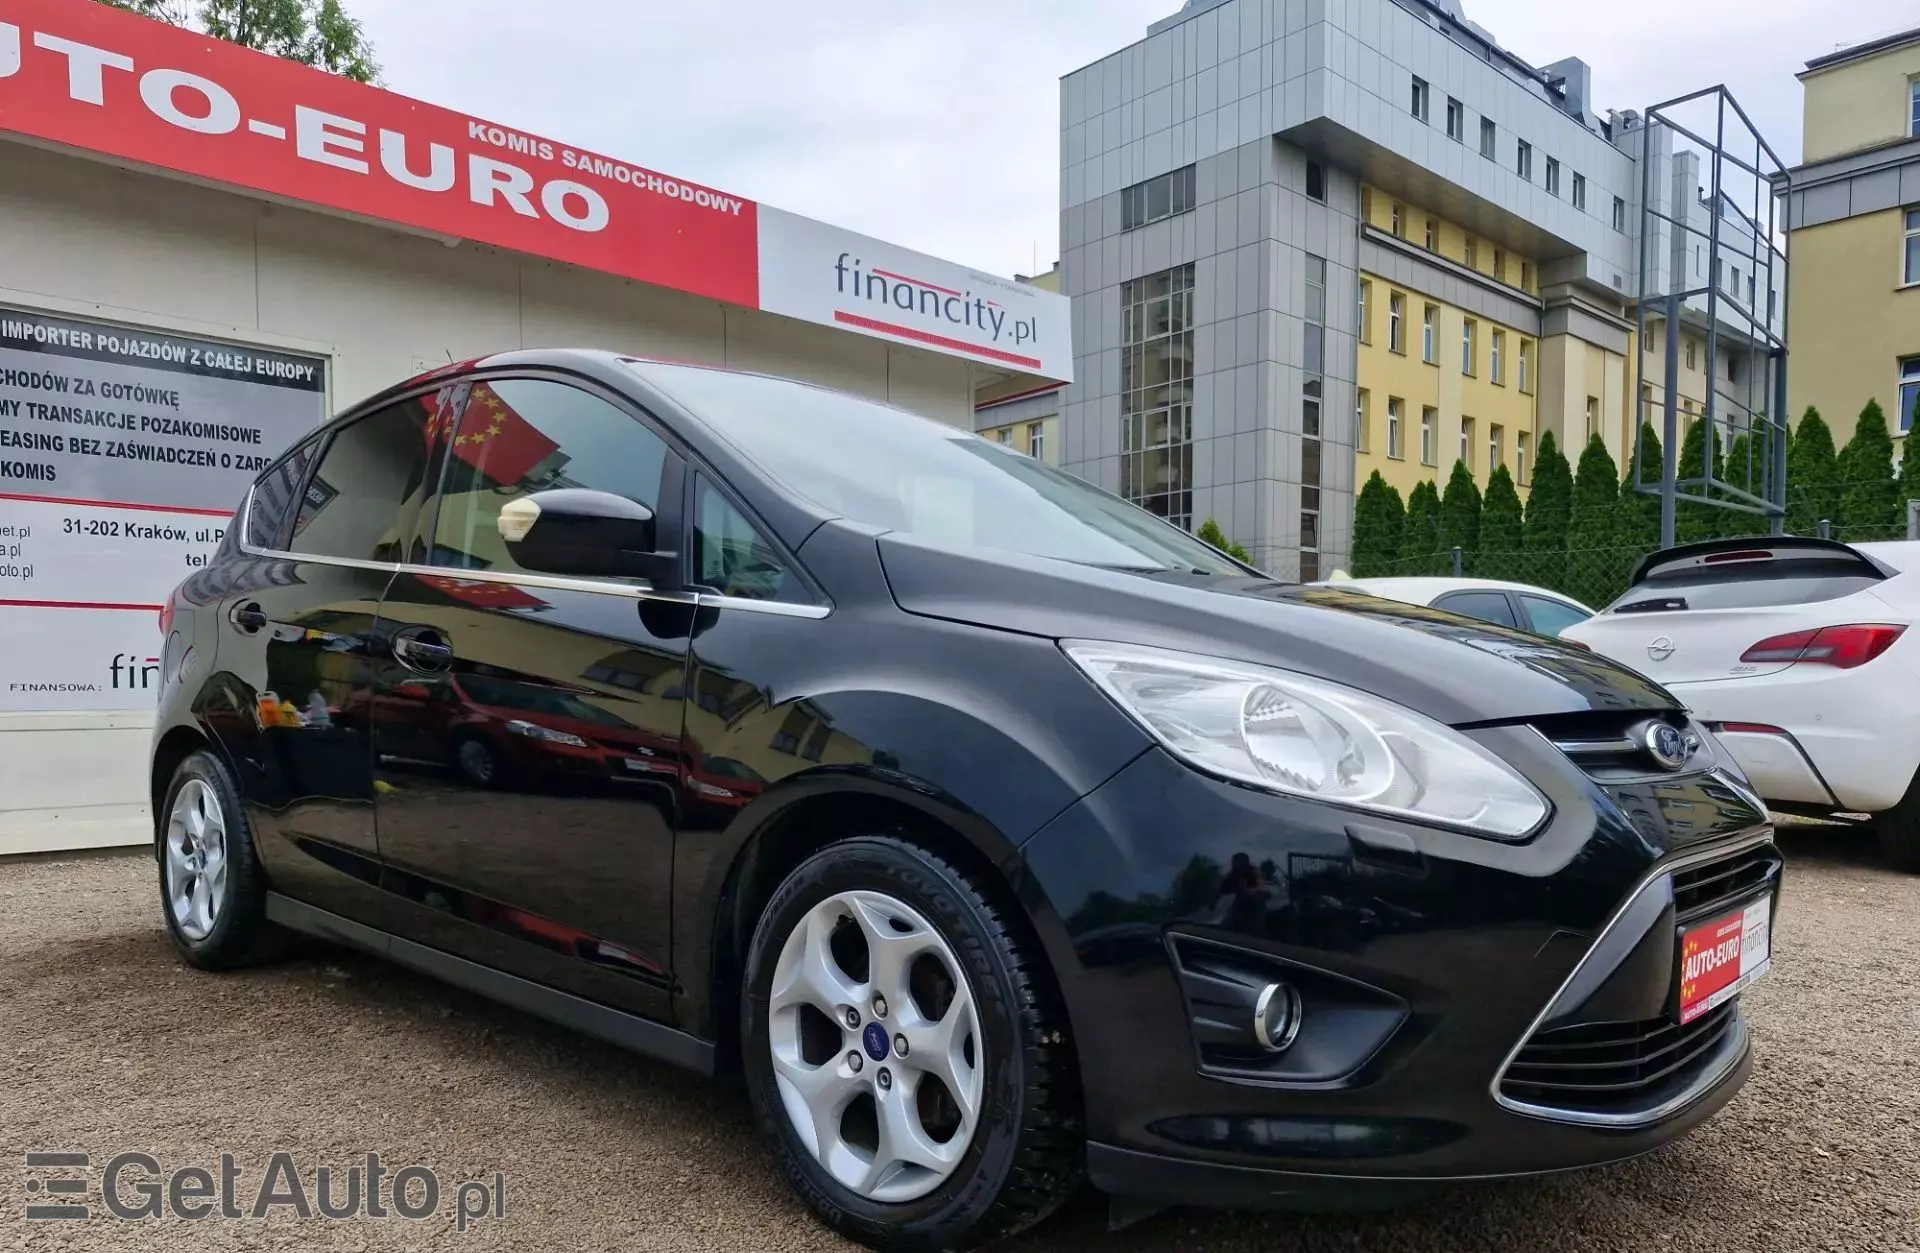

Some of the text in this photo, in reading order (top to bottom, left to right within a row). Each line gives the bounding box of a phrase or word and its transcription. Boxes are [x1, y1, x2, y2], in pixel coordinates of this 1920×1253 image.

[0, 22, 610, 233] TO-EURO
[468, 120, 743, 216] KOMIS SAMOCHODOWY
[834, 253, 1037, 345] financity.pl
[2, 319, 314, 382] IMPORTER POJAZDÓW Z CAŁEJ EUROPY
[74, 378, 96, 396] ZA
[100, 382, 179, 411] GOTÓWKĘ
[26, 402, 136, 430] TRANSAKCJE
[141, 415, 261, 444] POZAKOMISOWE
[0, 461, 56, 481] KOMIS
[69, 437, 101, 455] BEZ
[106, 440, 216, 467] ZAŚWIADCZEŃ
[221, 453, 231, 468] O
[63, 518, 119, 536] 31-202
[125, 522, 190, 543] Kraków,
[186, 554, 207, 566] tel
[10, 683, 102, 692] FINANSOWA:
[1685, 935, 1741, 982] AUTO-EURO
